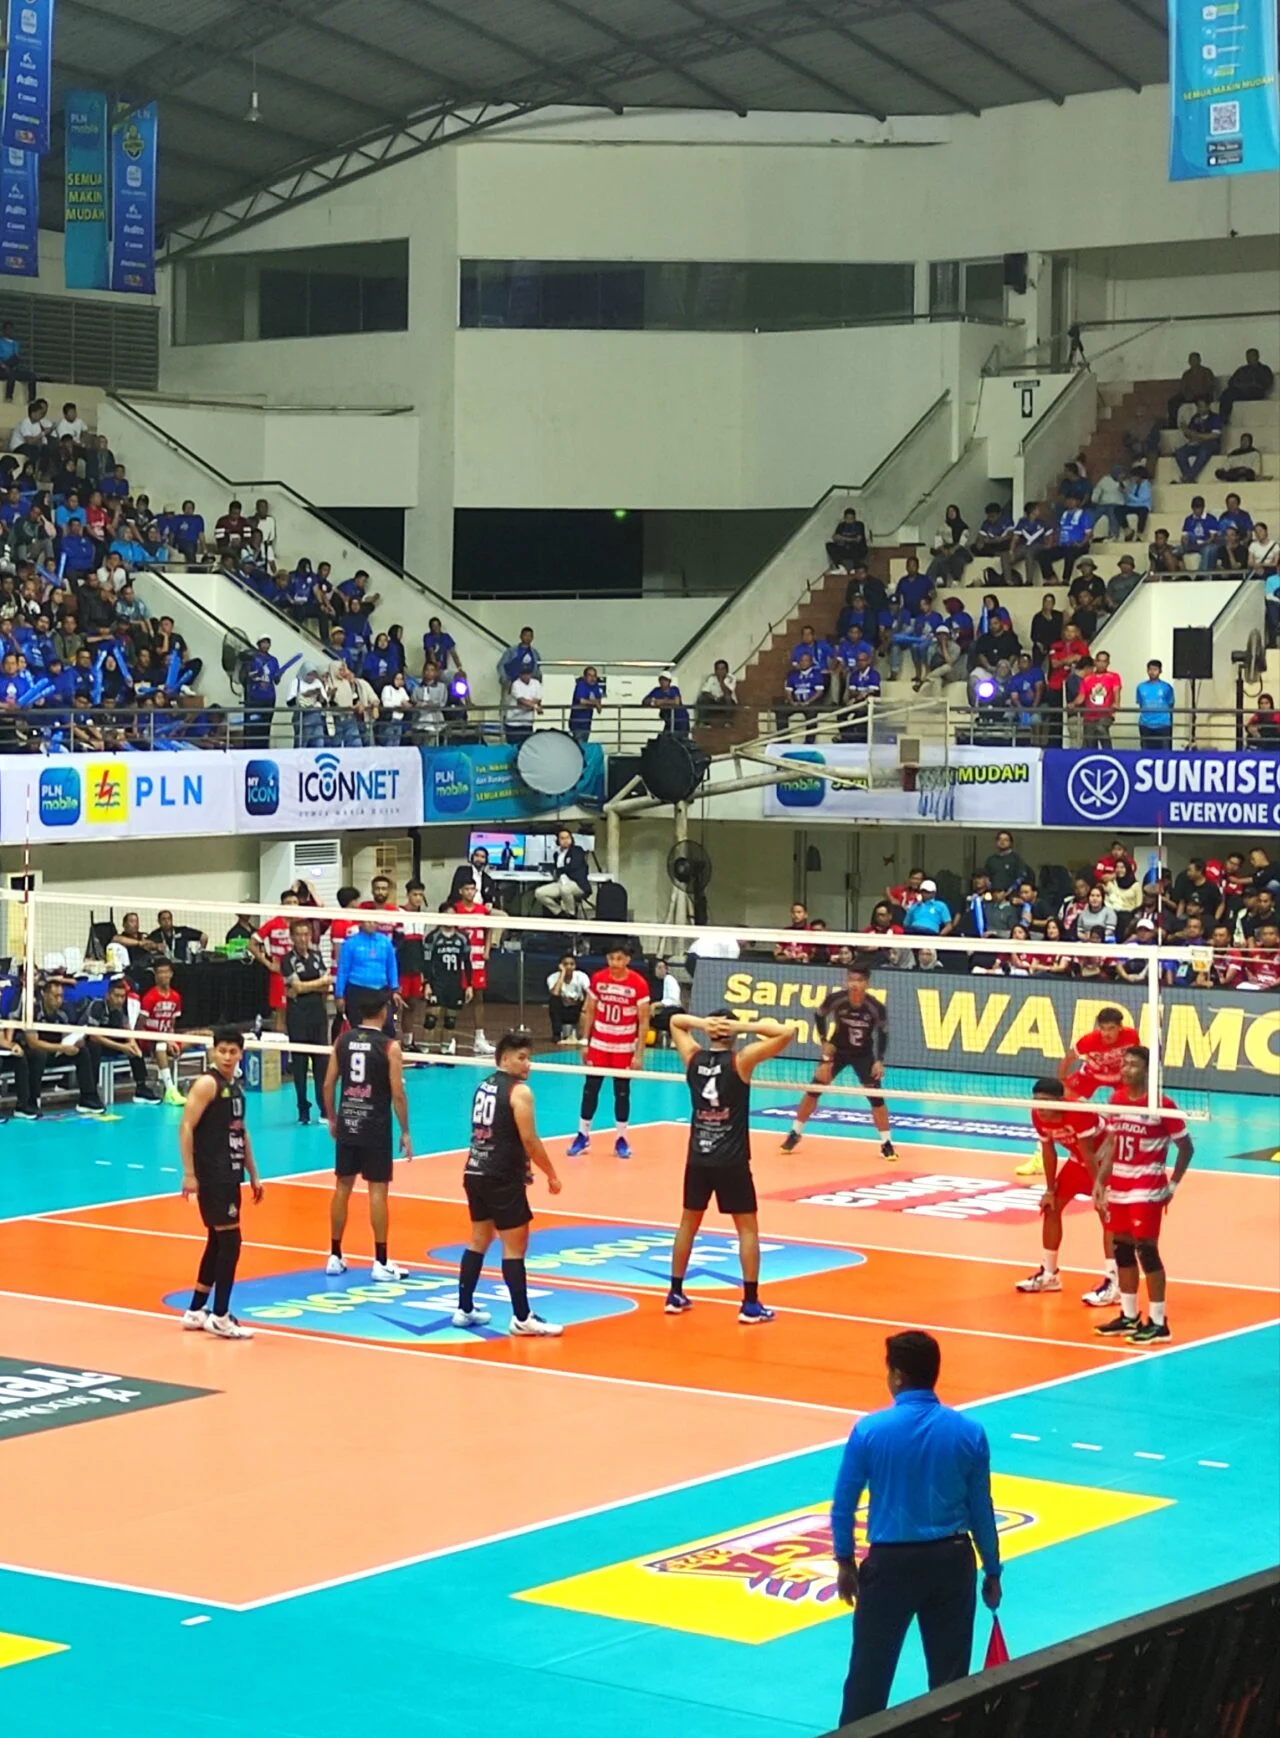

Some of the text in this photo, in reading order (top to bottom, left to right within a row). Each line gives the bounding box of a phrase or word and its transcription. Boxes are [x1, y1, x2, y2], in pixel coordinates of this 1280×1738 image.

[67, 173, 103, 187] SEMUA
[68, 191, 102, 203] MAKIN
[65, 208, 105, 222] MUDAH
[247, 776, 260, 787] MY
[435, 771, 455, 784] PLN
[958, 764, 1029, 785] MUDAH
[1133, 758, 1280, 794] SUNRISE
[41, 784, 63, 797] PLN
[135, 774, 203, 807] PLN
[247, 786, 277, 803] ICON
[298, 768, 400, 803] ICONNET
[435, 782, 469, 797] mobile
[41, 796, 79, 811] mobile
[1169, 801, 1269, 824] EVERYONE
[441, 954, 458, 971] 99
[723, 973, 887, 1009] Saru
[605, 1004, 621, 1024] 10
[349, 1052, 366, 1083] 9
[701, 1076, 720, 1107] 4
[472, 1090, 497, 1126] 20
[1108, 1121, 1148, 1135] ARUDA
[1118, 1135, 1135, 1161] 15
[793, 1174, 1013, 1208] Bima
[902, 1183, 1043, 1219] uku
[242, 1274, 459, 1319] mobile
